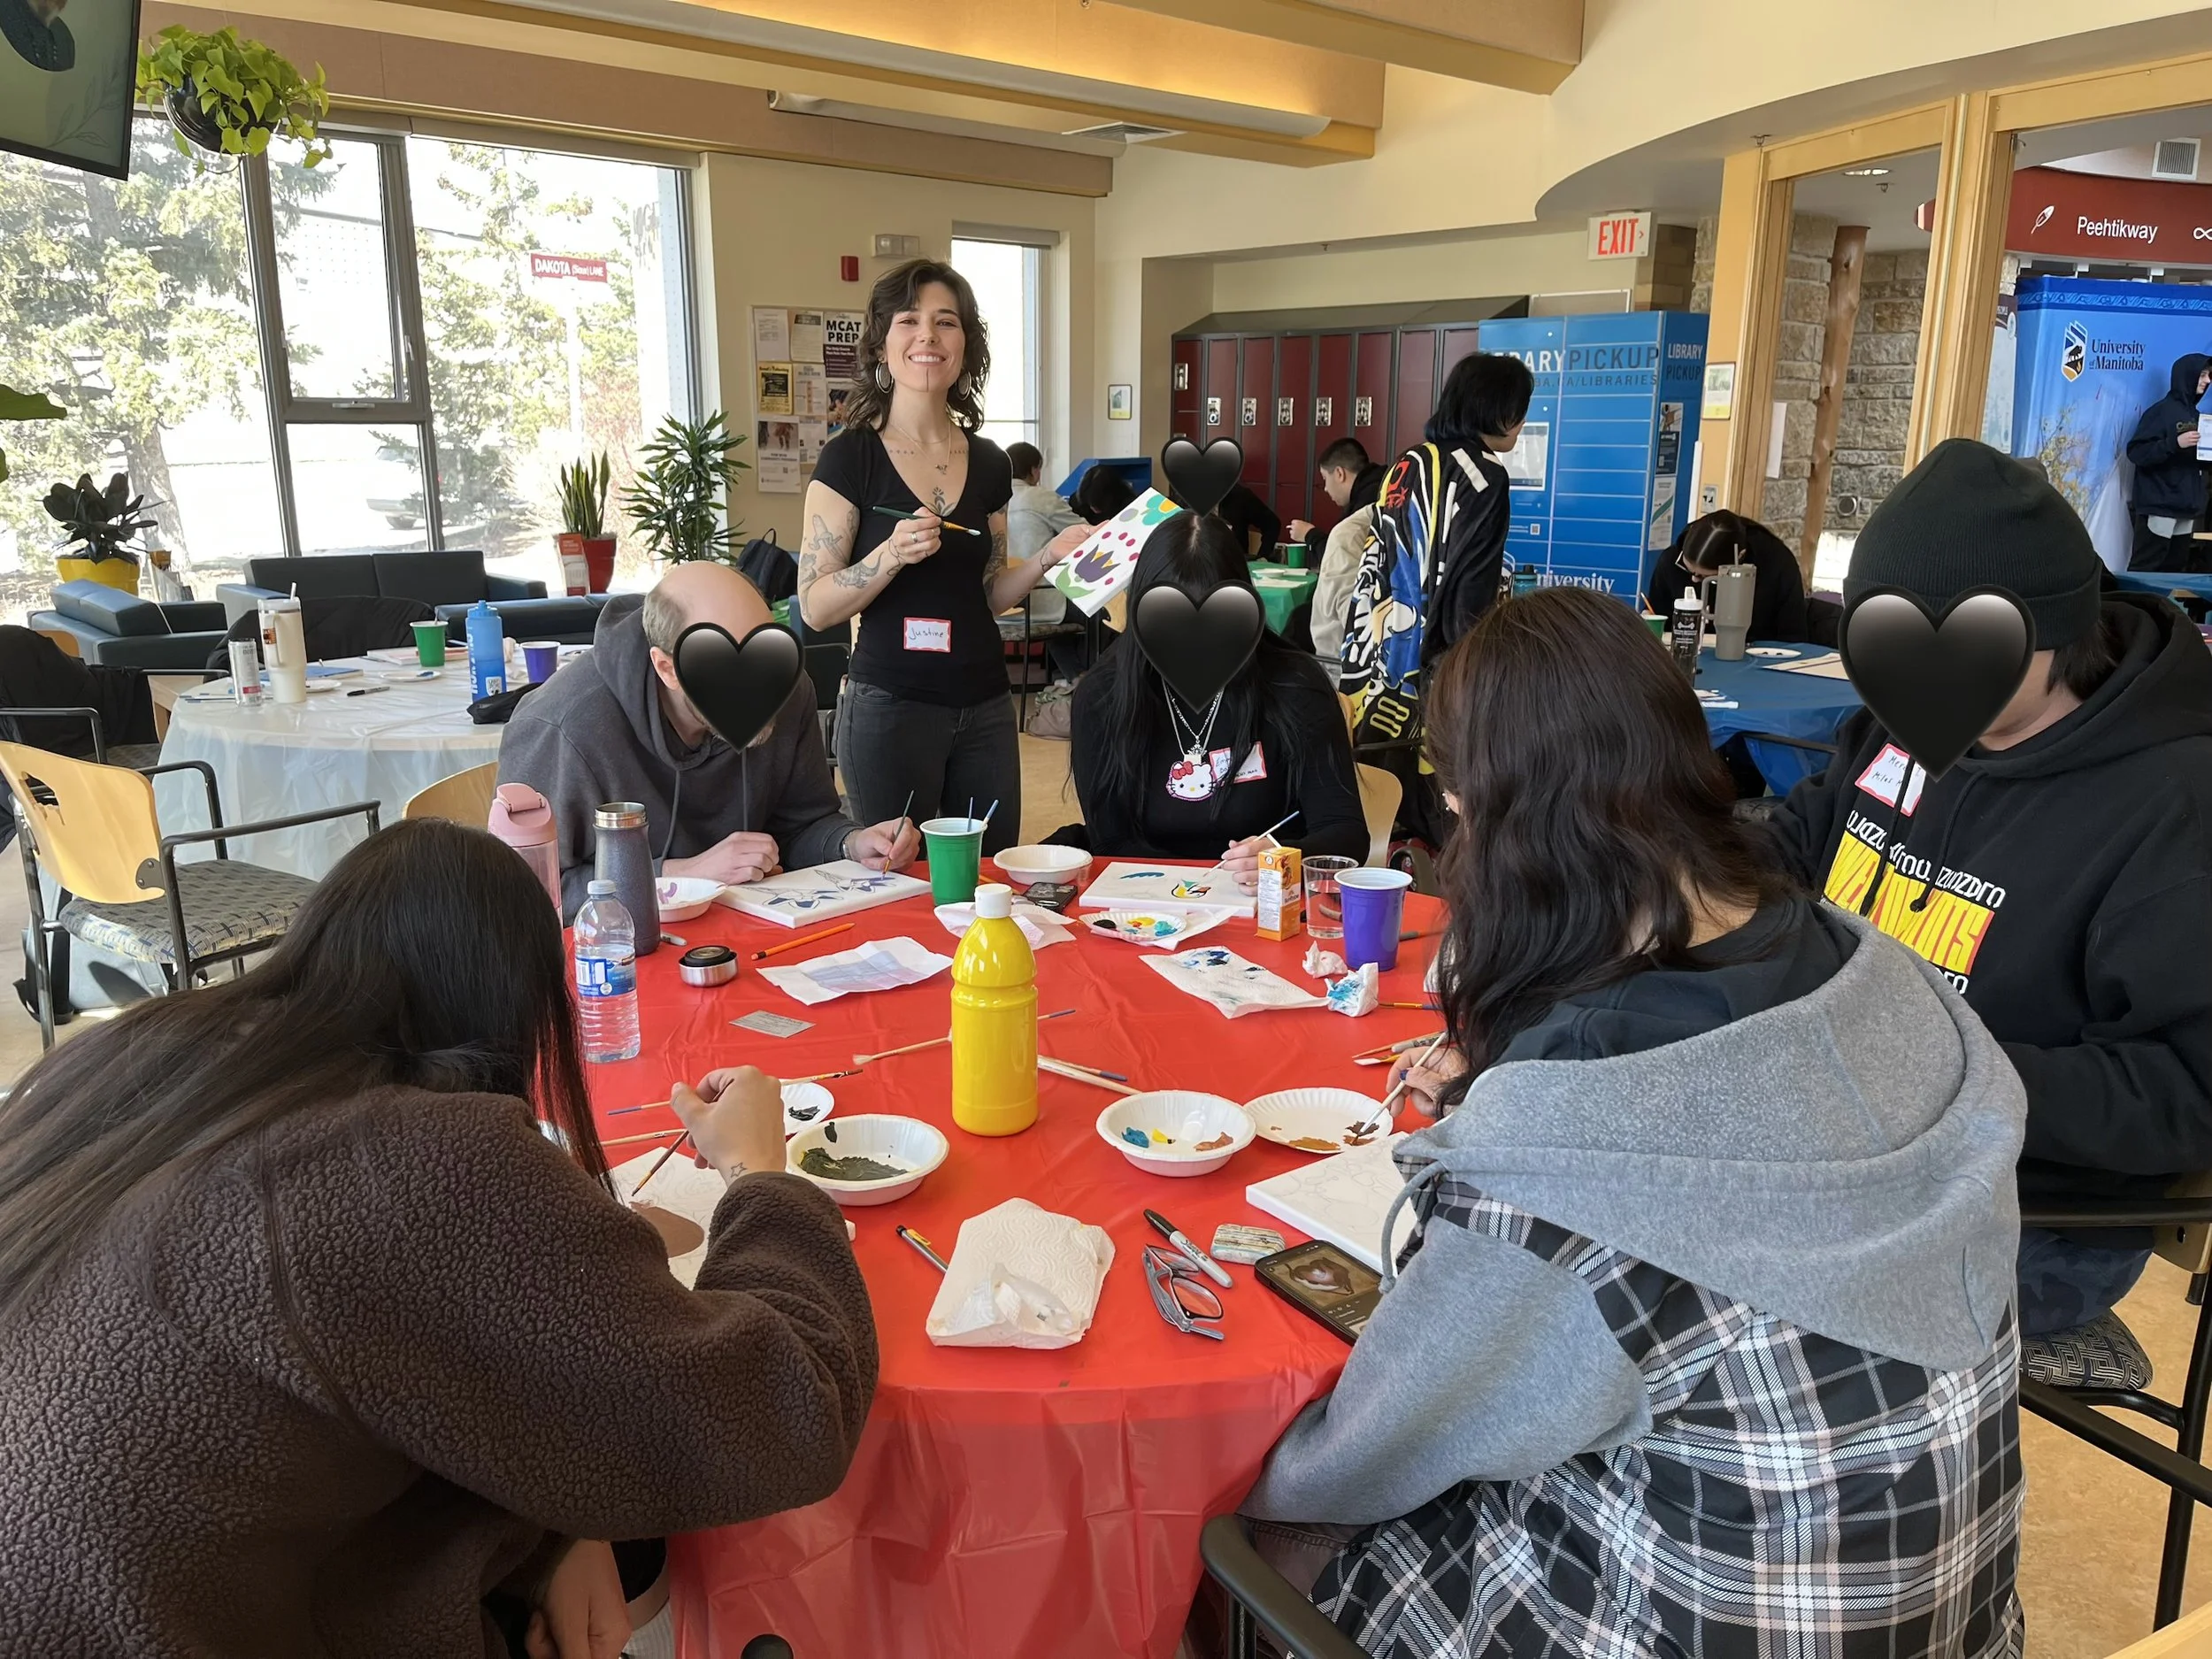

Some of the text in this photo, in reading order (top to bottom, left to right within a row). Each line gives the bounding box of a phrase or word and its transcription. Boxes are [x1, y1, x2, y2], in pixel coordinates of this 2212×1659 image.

[1598, 218, 1639, 255] EXIT
[2077, 216, 2158, 244] Peehtikway
[534, 258, 571, 275] DAKOTA
[826, 320, 861, 333] MCAT
[828, 332, 859, 343] PREP
[1668, 342, 1703, 361] LIBRARY
[2092, 338, 2146, 358] University
[1569, 347, 1659, 371] PICKUP
[2095, 356, 2144, 371] Manitoba
[1666, 364, 1701, 381] PICKUP
[1533, 569, 1615, 593] niversity
[909, 627, 943, 641] Justine
